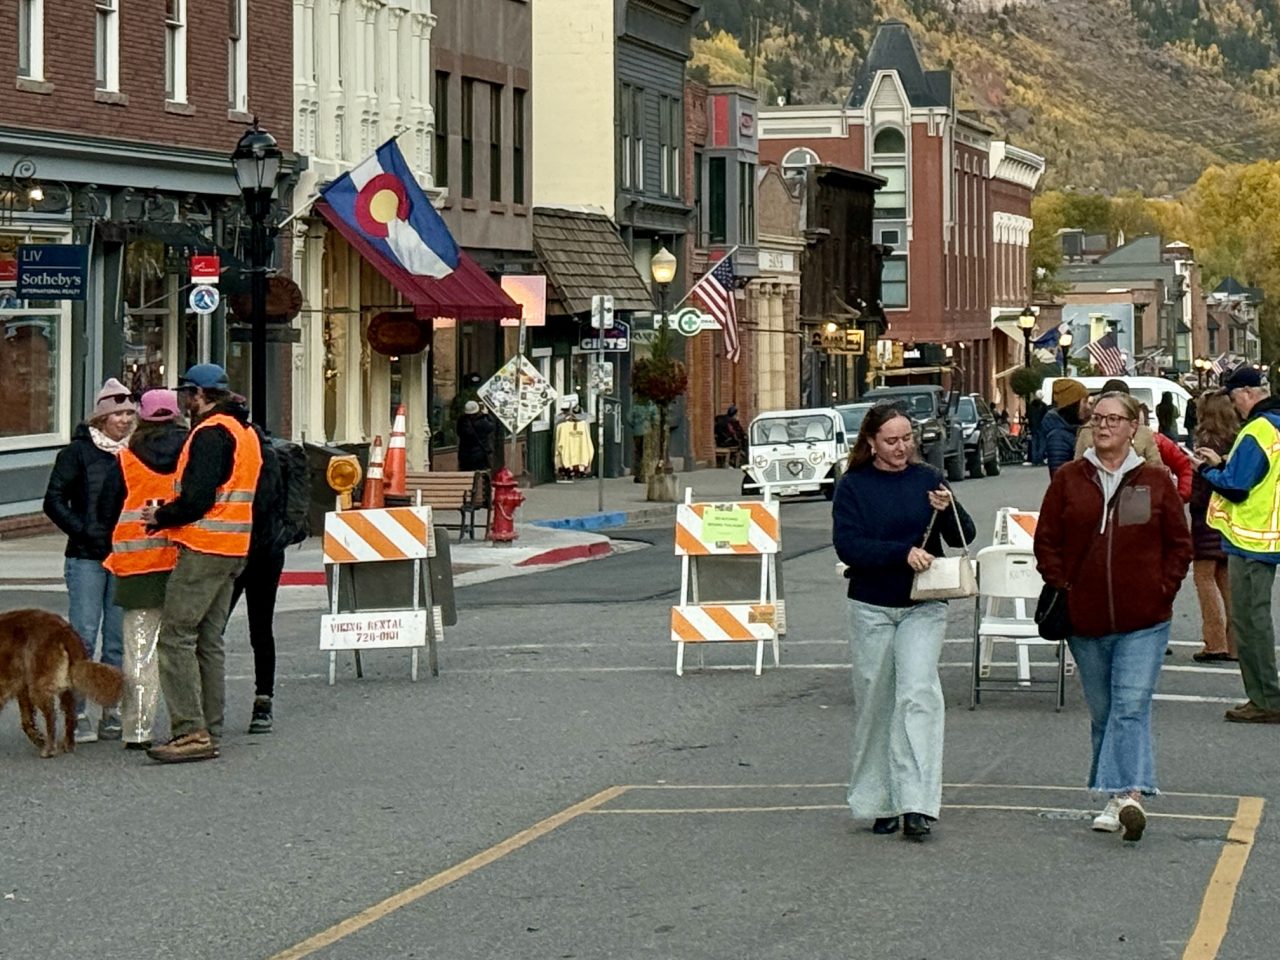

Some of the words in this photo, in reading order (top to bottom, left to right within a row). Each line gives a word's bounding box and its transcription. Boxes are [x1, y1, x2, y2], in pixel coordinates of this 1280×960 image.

[22, 250, 43, 262] LIV
[21, 272, 81, 288] Sotheby's
[330, 622, 362, 633] VIKING
[367, 619, 404, 631] RENTAL
